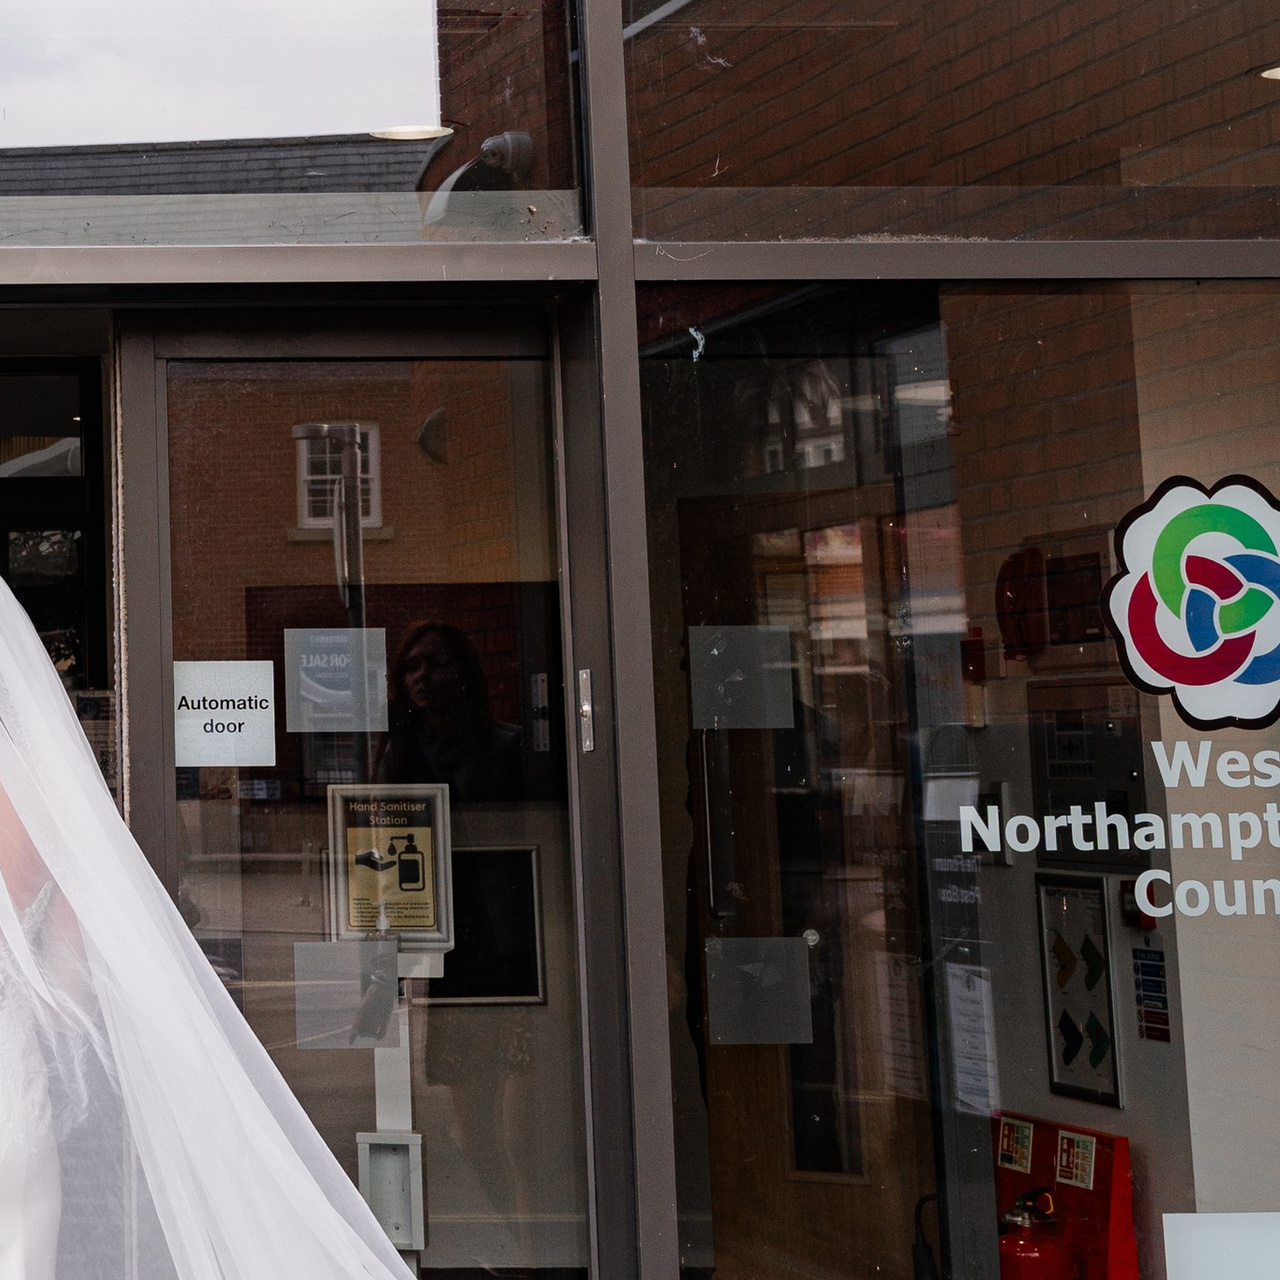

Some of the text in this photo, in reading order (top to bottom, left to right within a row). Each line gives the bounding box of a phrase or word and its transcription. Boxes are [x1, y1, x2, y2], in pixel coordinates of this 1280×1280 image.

[176, 694, 270, 711] Automatic
[203, 718, 246, 734] door
[1150, 740, 1280, 788] Wes
[349, 801, 426, 812] Hand Sanitiser
[369, 815, 408, 825] Station
[959, 801, 1280, 861] Northampt
[1134, 869, 1280, 917] Coun
